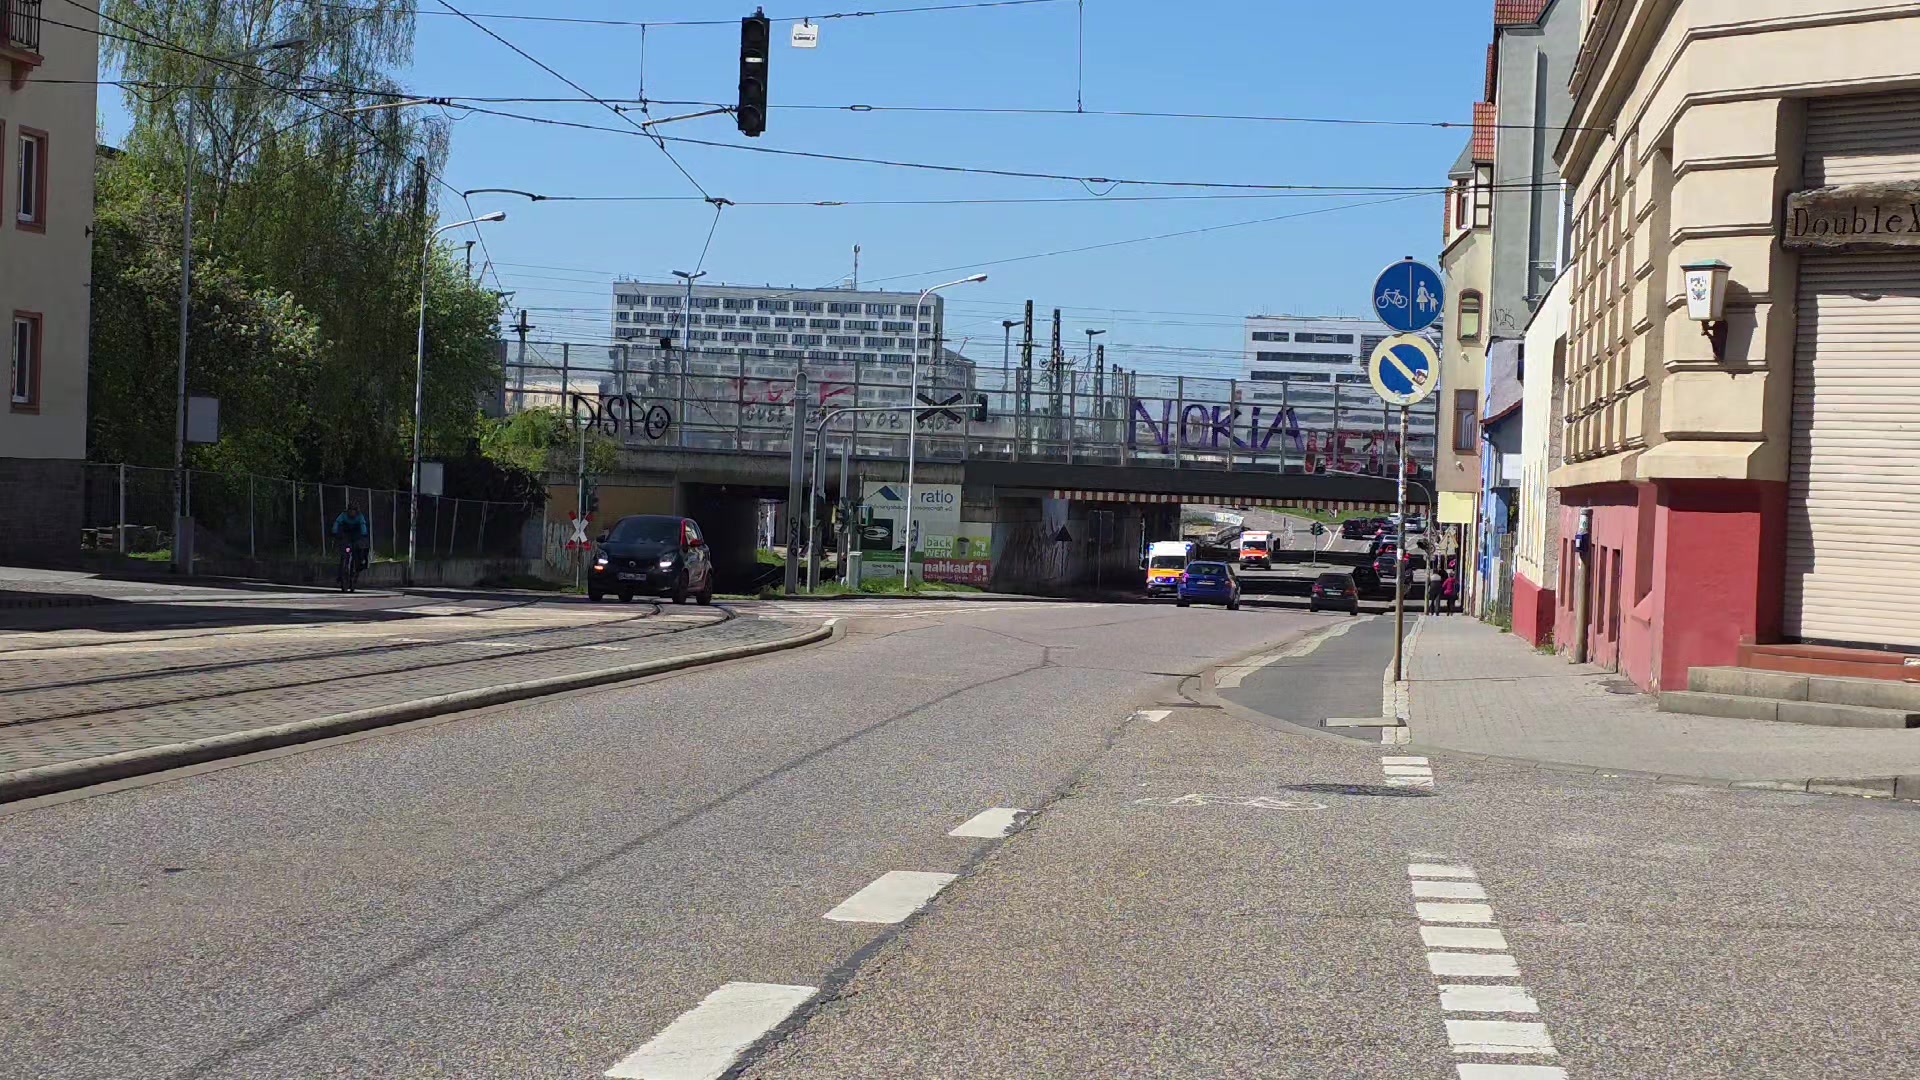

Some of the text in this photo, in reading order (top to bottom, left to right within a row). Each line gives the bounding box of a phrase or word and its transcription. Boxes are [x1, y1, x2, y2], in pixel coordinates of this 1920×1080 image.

[1793, 203, 1920, 237] DoubleX
[920, 489, 954, 504] ratio
[925, 536, 953, 548] back
[924, 549, 953, 558] WERK
[924, 560, 974, 574] nahkauf
